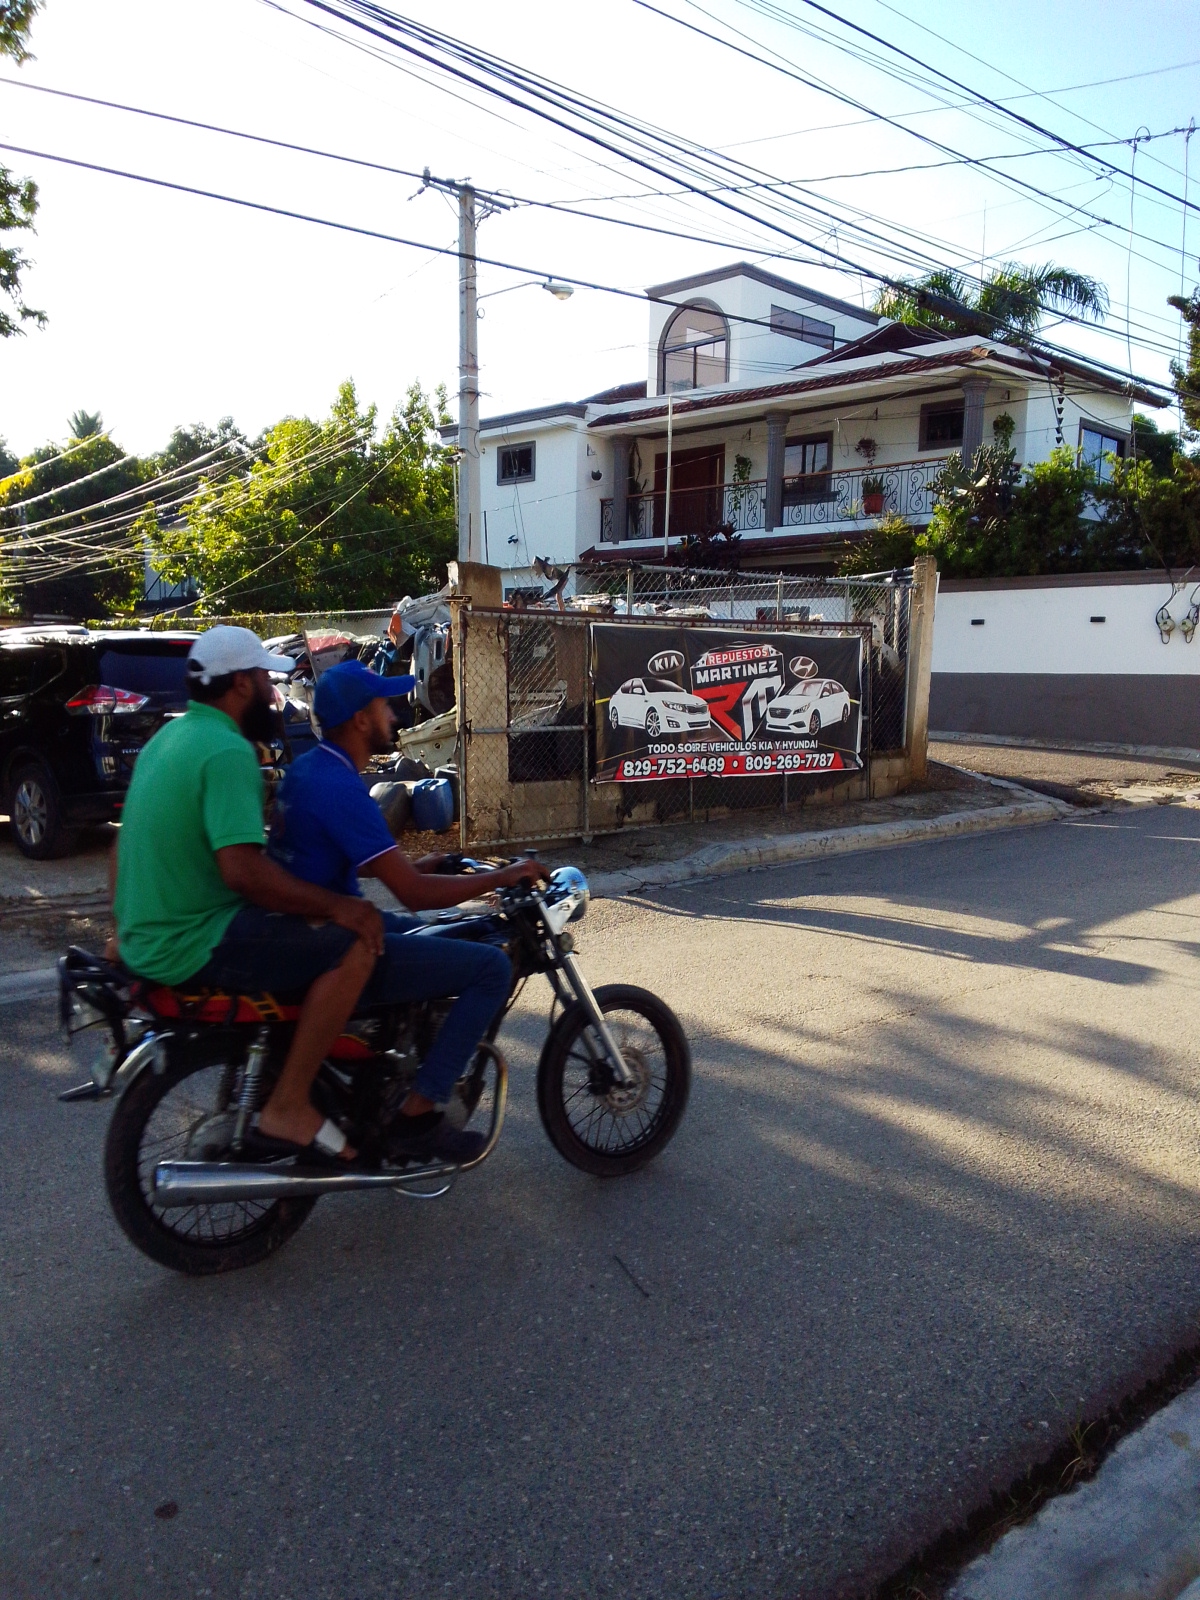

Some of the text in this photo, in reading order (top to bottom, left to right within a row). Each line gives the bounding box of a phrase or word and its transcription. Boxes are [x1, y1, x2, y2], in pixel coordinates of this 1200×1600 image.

[654, 655, 680, 672] KIA
[709, 649, 768, 665] REPUESTOS
[696, 660, 779, 684] MARTINEZ
[648, 743, 676, 754] TODO
[708, 741, 757, 753] VEHICULOS
[758, 741, 773, 751] KIA
[775, 740, 782, 749] Y
[782, 740, 819, 750] HYUNDAI
[623, 752, 835, 777] 829-752-6489 809-269-7787
